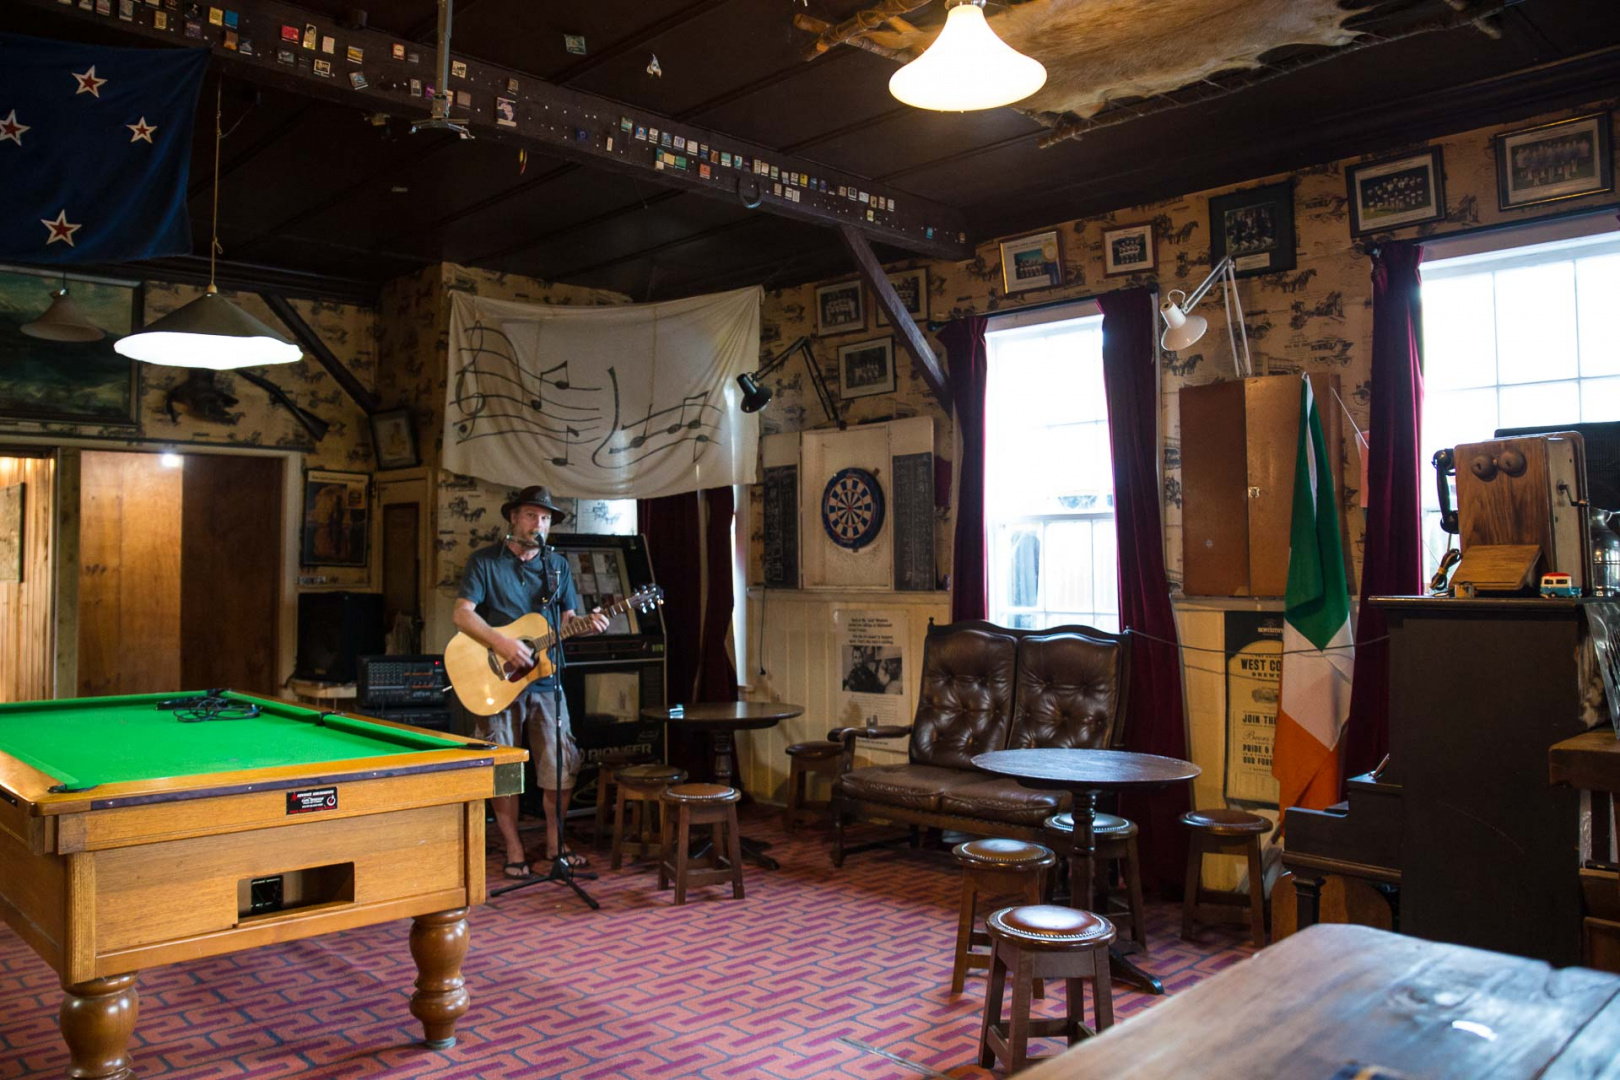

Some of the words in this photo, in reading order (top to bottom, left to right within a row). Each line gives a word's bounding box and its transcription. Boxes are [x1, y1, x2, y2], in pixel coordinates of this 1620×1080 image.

[1241, 658, 1266, 671] WEST
[1242, 714, 1260, 724] JOIN
[1242, 744, 1262, 753] PRIDE
[1243, 756, 1255, 765] OUR
